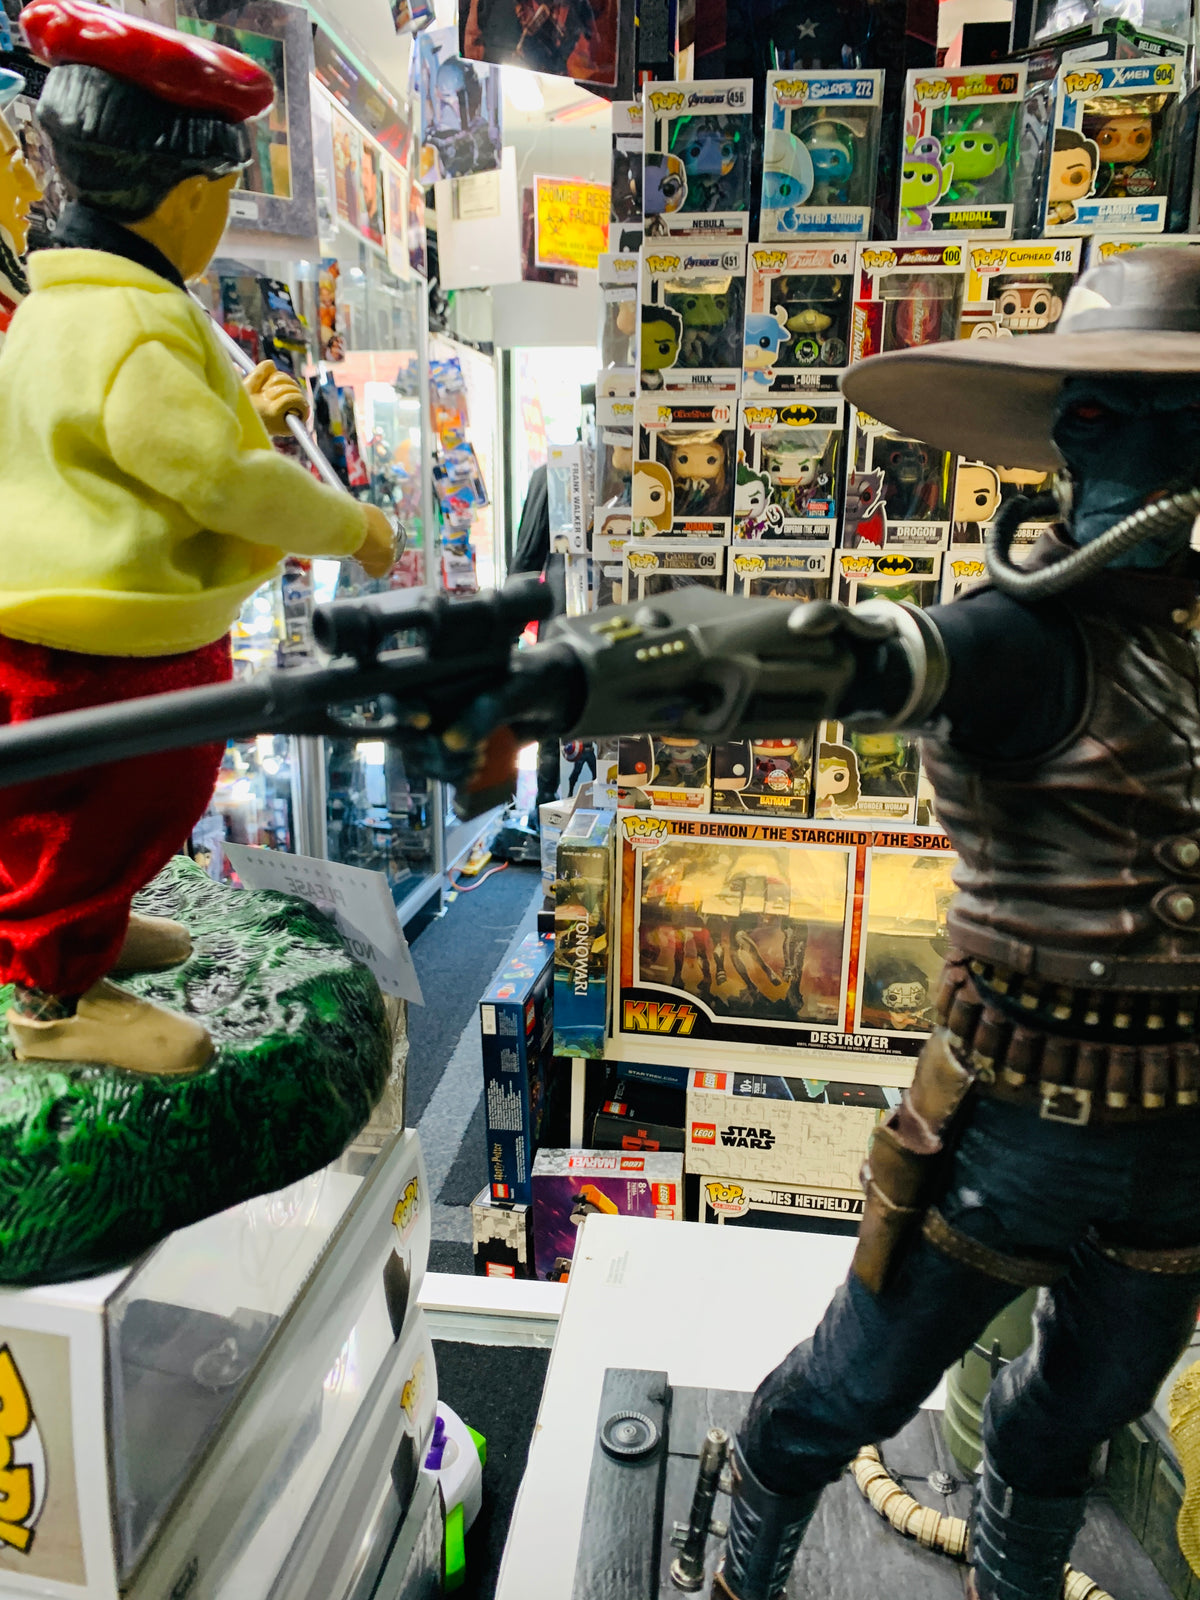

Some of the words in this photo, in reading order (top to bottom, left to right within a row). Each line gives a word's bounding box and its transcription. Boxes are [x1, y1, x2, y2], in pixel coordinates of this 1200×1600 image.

[1156, 68, 1172, 81] 904
[773, 80, 808, 98] POP!
[856, 81, 872, 96] 272
[915, 80, 951, 101] POP!
[1064, 72, 1103, 94] POP!
[730, 91, 744, 103] 456
[957, 85, 994, 101] REMIX
[648, 91, 685, 113] POP!
[569, 208, 610, 226] FACILIT
[692, 219, 725, 228] NEBULA
[830, 213, 861, 225] SMURF
[949, 211, 993, 222] RANDALL
[833, 253, 847, 265] 04
[861, 250, 897, 268] POP!
[945, 250, 960, 262] 100
[970, 248, 1008, 267] POP!
[1009, 252, 1052, 262] CUPHEAD
[1054, 250, 1071, 262] 418
[1098, 241, 1137, 262] POP
[646, 253, 680, 274] POP!
[724, 256, 738, 267] 451
[752, 250, 788, 269] POP!
[691, 375, 713, 384] HULK
[793, 374, 821, 385] T-BONE
[713, 408, 728, 420] 711
[743, 406, 778, 424] POP!
[571, 463, 580, 493] FRANK
[572, 496, 582, 533] WALKER
[896, 526, 937, 537] DROGON
[626, 552, 659, 569] POP!
[701, 555, 715, 567] 09
[733, 555, 766, 573] POP!
[809, 558, 822, 569] 01
[840, 556, 874, 572] POP!
[950, 560, 985, 578] POP!
[759, 795, 791, 806] BATMAN
[858, 801, 883, 810] WONDER
[884, 802, 907, 811] WOMAN
[622, 815, 668, 838] POP!
[671, 821, 695, 835] THE
[700, 823, 748, 838] DEMON
[752, 826, 758, 839] /
[761, 827, 787, 840] THE
[790, 828, 867, 845] STARCHILD
[882, 832, 909, 848] THE
[913, 834, 950, 849] SPAC
[573, 912, 591, 997] TONOWARI
[623, 999, 698, 1036] KISS
[810, 1031, 889, 1049] DESTROYER
[628, 1069, 679, 1082] STARTREK.COM
[740, 1079, 752, 1093] 10+
[693, 1128, 715, 1139] LEGO
[720, 1125, 776, 1140] STAR
[720, 1135, 776, 1150] WARS
[568, 1156, 617, 1169] MARVEL
[620, 1160, 643, 1169] LEGO
[638, 1182, 647, 1195] 8+
[706, 1181, 748, 1205] POP!
[795, 1192, 850, 1212] HETFIELD
[852, 1200, 858, 1212] /
